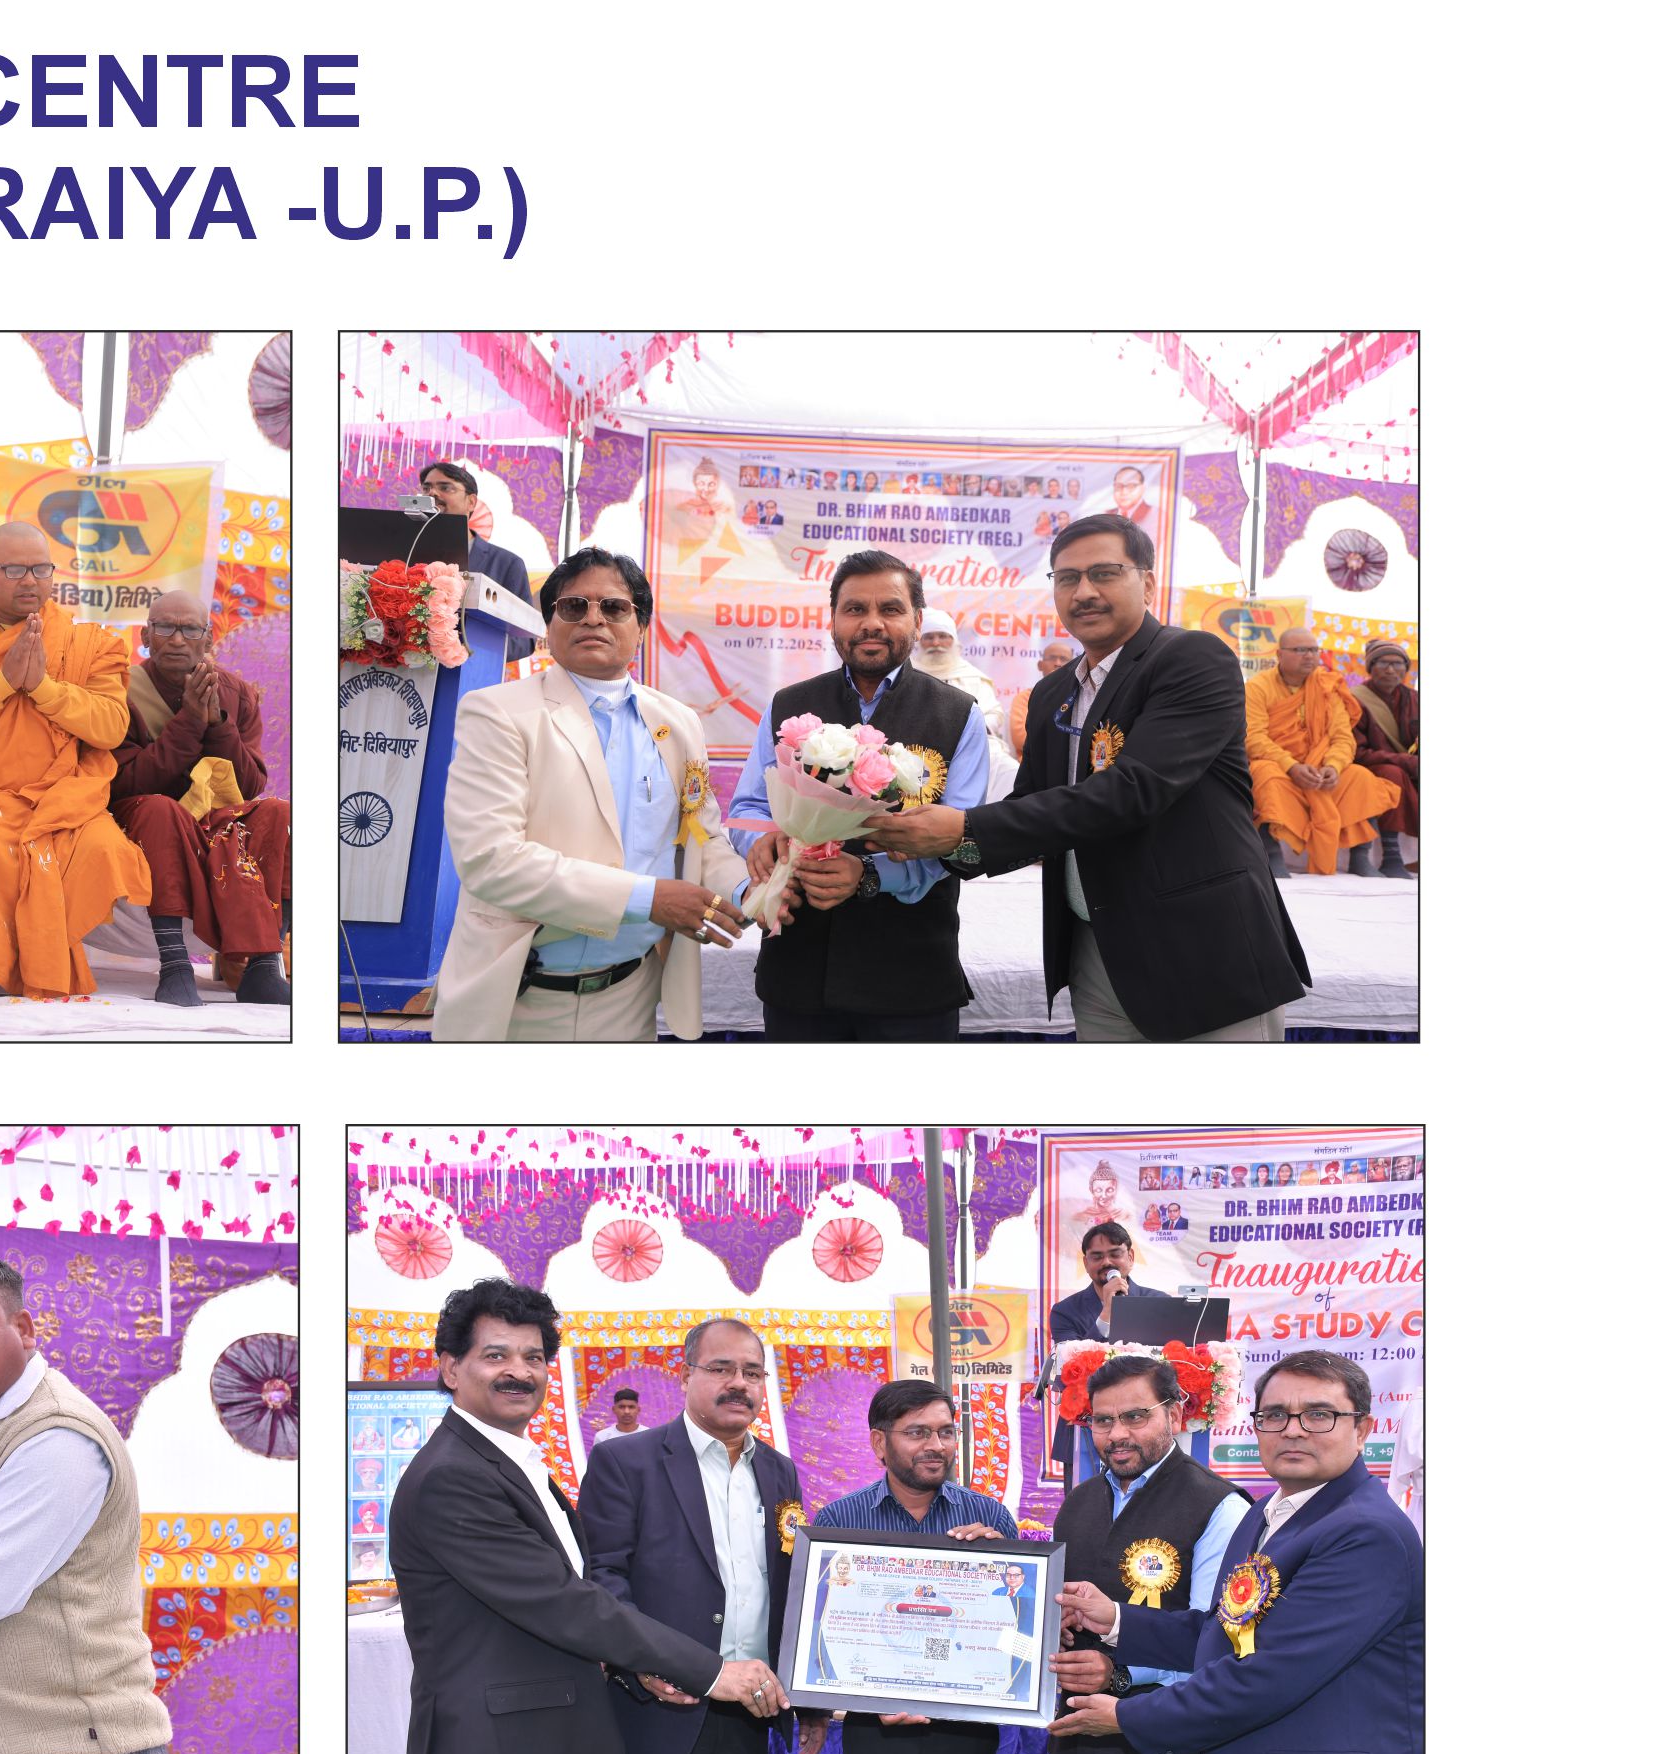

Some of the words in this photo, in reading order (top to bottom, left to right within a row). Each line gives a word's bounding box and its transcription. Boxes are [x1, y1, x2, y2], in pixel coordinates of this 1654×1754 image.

[816, 501, 842, 520] DR.
[845, 503, 888, 522] BHIM
[890, 504, 923, 523] RAO
[926, 505, 1012, 525] AMBEDKAR
[803, 523, 908, 544] EDUCATIONAL
[909, 525, 974, 547] SOCIETY
[977, 529, 1023, 549] (REG.)
[69, 558, 120, 573] GAIL
[715, 602, 837, 631] BUDDH
[973, 610, 1068, 639] CENTE
[724, 638, 743, 649] on
[746, 635, 828, 653] 07.12.2025,
[991, 645, 1015, 658] PM
[1224, 1200, 1252, 1218] DR.
[1256, 1198, 1306, 1217] BHIM
[1308, 1196, 1343, 1215] RAO
[1209, 1222, 1324, 1243] EDUCATIONAL
[1326, 1219, 1404, 1240] SOCIETY
[1314, 1286, 1336, 1312] of
[1272, 1311, 1391, 1341] STUDY
[1371, 1346, 1416, 1361] 12:00
[910, 1363, 929, 1376] गेल
[972, 1361, 1013, 1375] लिमिटेड
